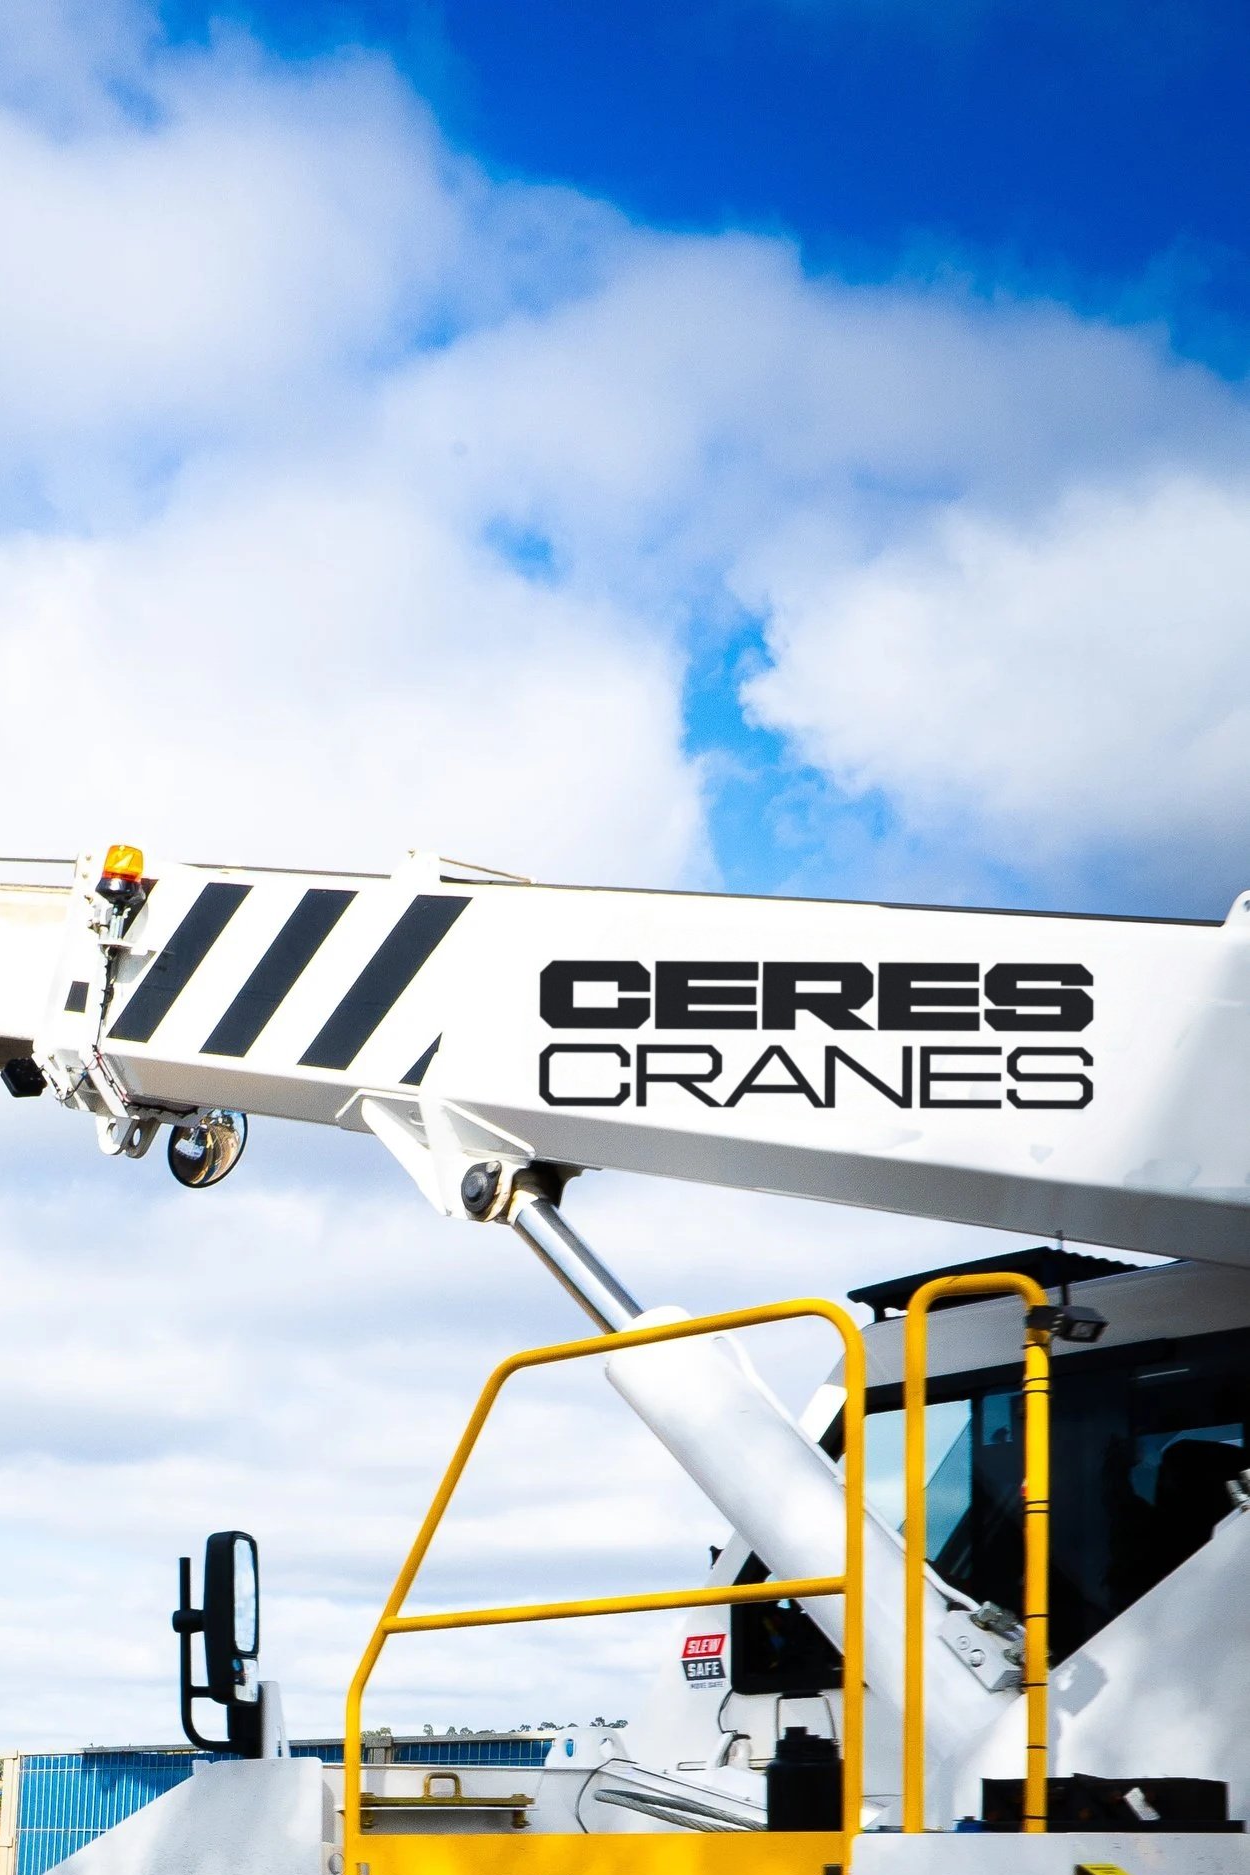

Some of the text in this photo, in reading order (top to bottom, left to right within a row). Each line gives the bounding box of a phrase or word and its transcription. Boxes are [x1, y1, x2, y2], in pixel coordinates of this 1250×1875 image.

[539, 959, 1094, 1032] CERES
[538, 1042, 1094, 1109] CRANES
[686, 1638, 722, 1654] SLEW
[687, 1661, 720, 1677] SAFE
